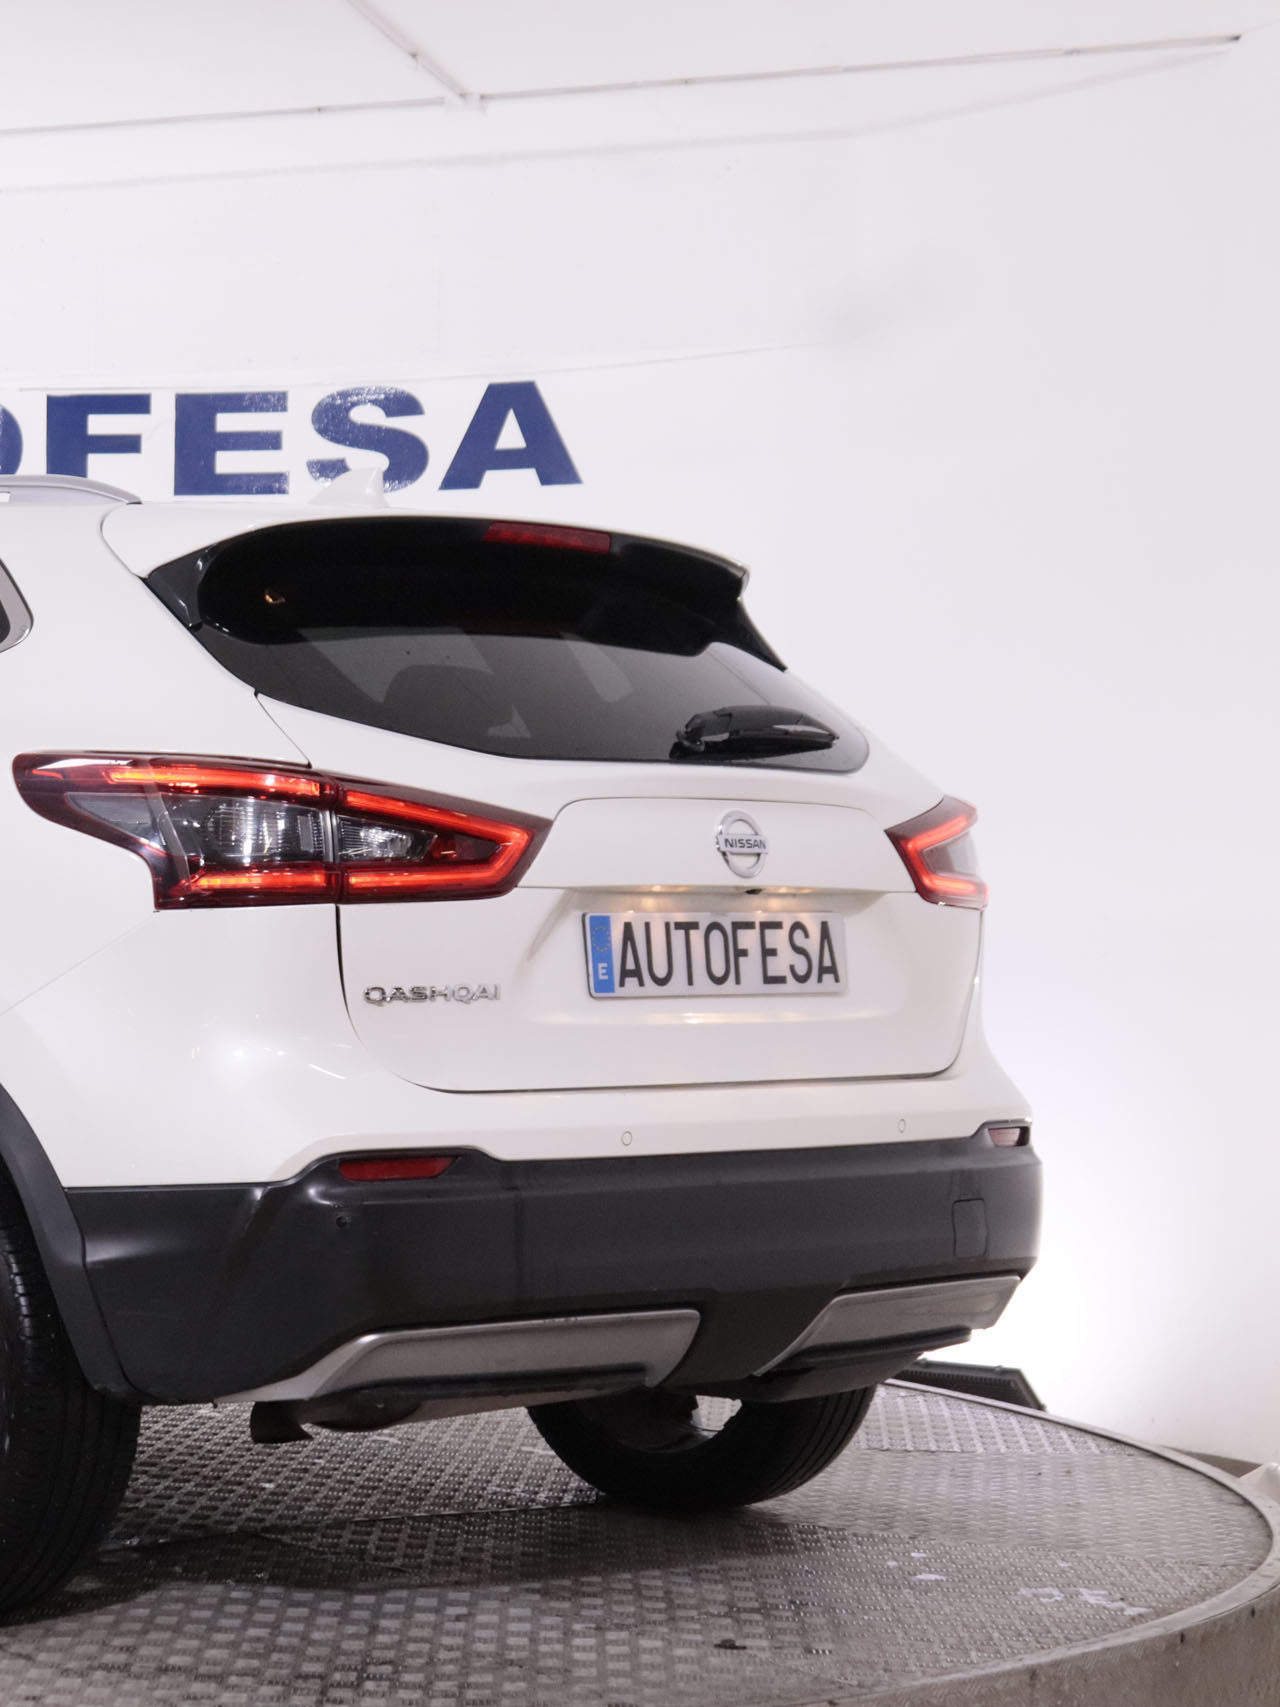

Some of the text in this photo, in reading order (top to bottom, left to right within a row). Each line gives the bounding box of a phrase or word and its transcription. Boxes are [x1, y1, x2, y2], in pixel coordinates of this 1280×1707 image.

[723, 838, 767, 849] NISSAN
[618, 921, 841, 988] AUTOFESA
[597, 963, 609, 980] E
[364, 984, 500, 1007] QASHQAI
